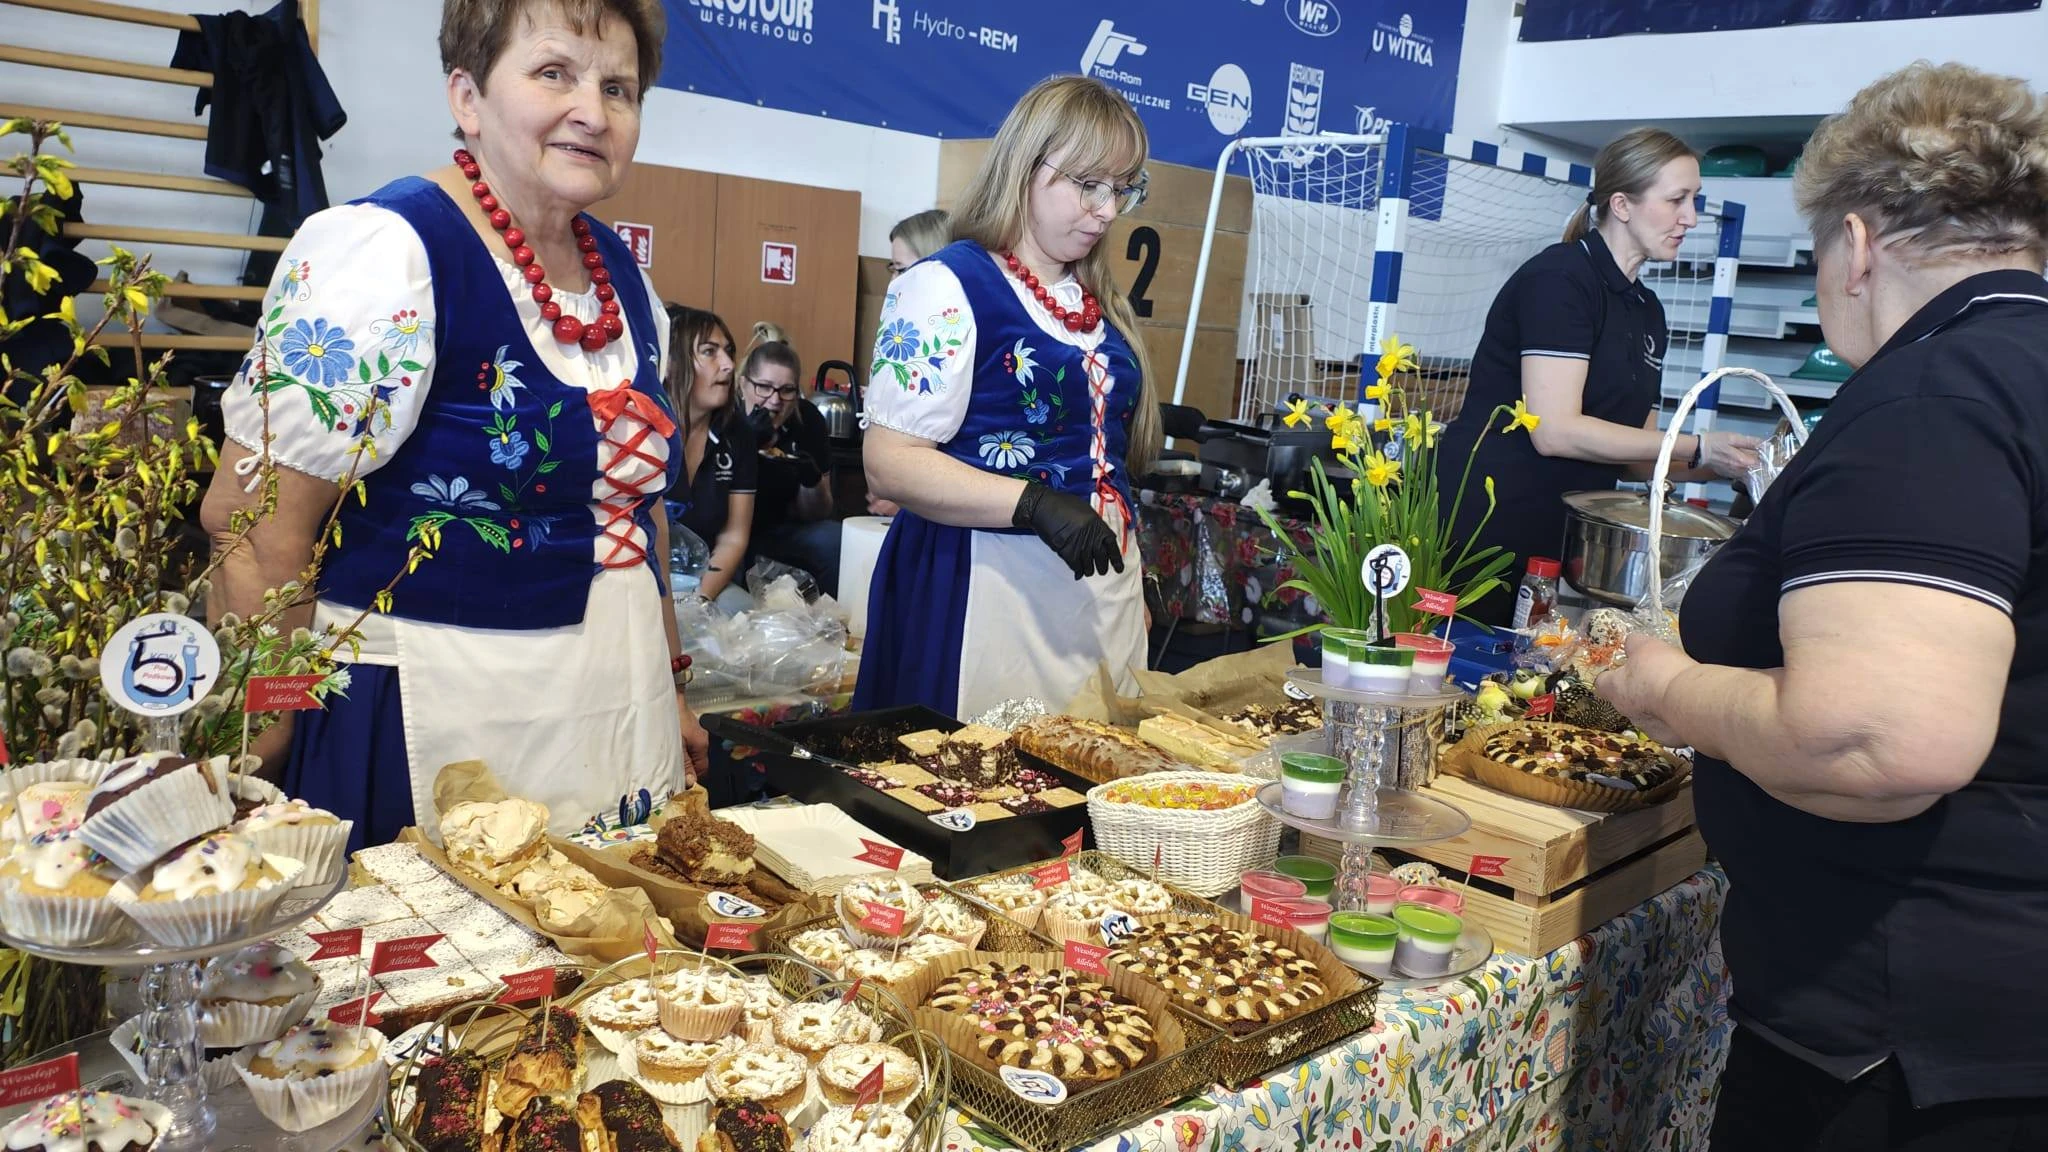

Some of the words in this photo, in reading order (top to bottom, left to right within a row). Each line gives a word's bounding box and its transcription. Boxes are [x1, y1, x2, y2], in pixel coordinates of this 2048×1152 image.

[700, 9, 813, 44] WEJHEROWO
[1372, 29, 1385, 52] U
[1388, 33, 1433, 67] WITKA
[1094, 65, 1142, 87] Tech-Rom
[1187, 82, 1251, 112] GEN
[1126, 226, 1161, 318] 2
[264, 694, 302, 706] Alleluja
[387, 953, 421, 967] Alleluja
